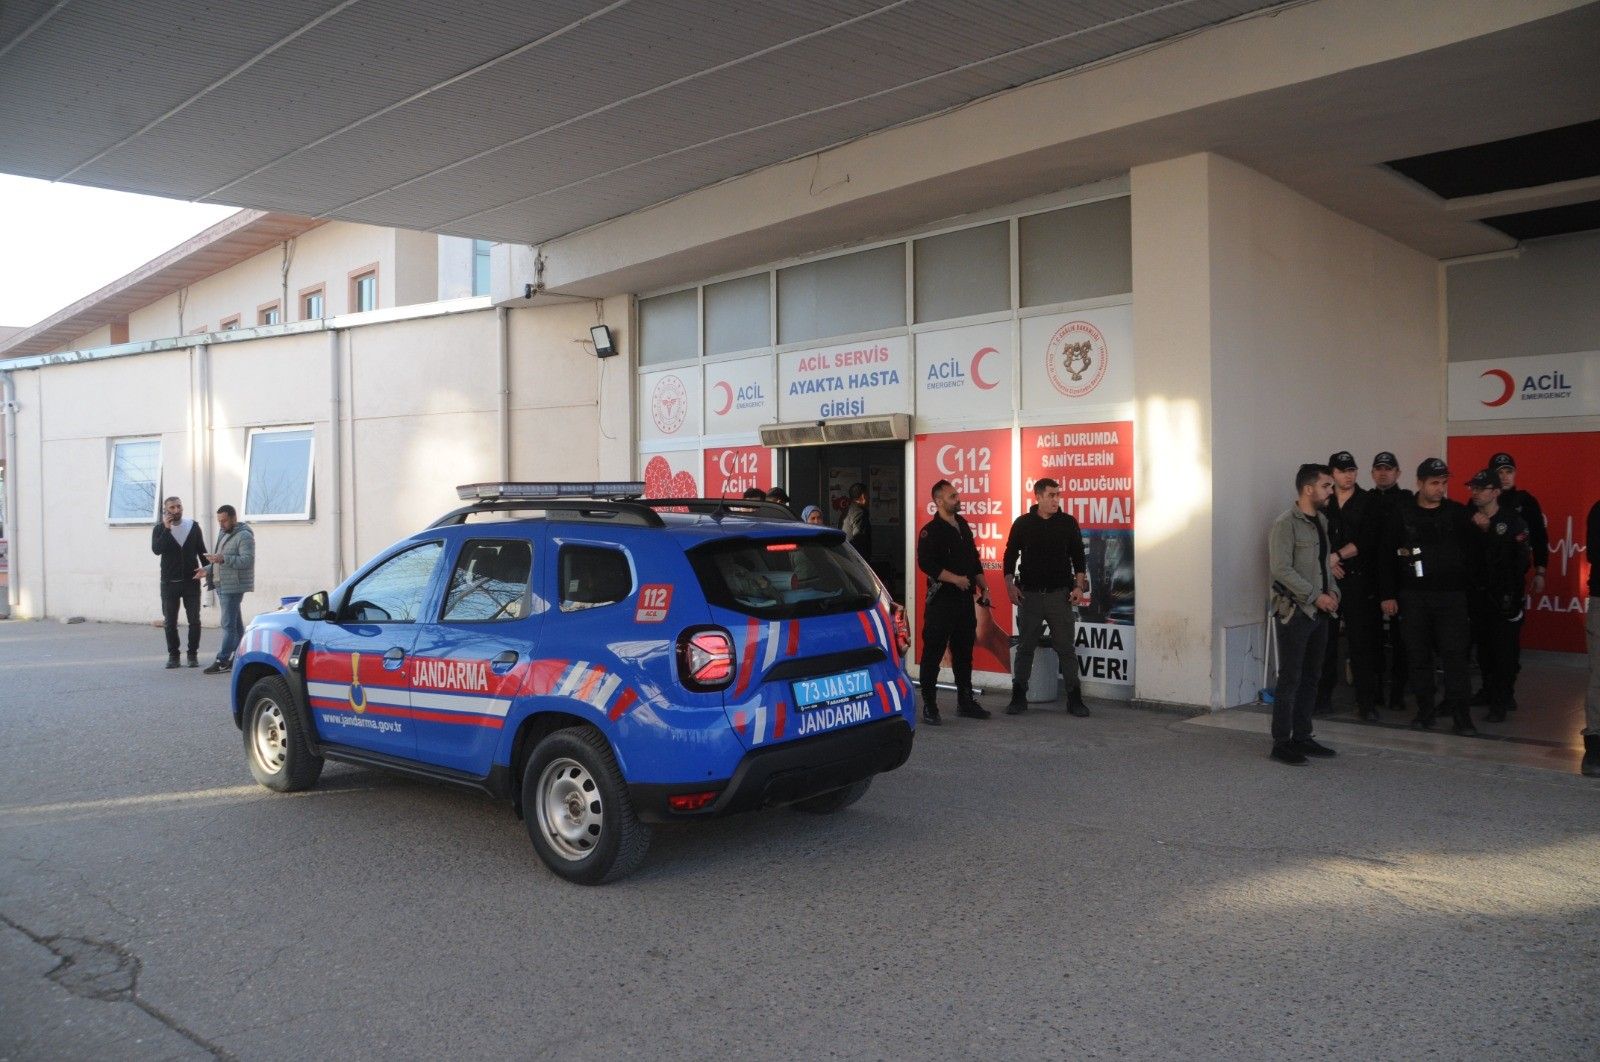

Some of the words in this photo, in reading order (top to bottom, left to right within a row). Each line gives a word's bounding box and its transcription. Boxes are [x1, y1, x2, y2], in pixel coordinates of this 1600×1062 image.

[798, 353, 830, 372] ACİL
[834, 345, 889, 368] SERVİS
[928, 357, 965, 380] ACİL
[789, 376, 844, 396] AYAKTA
[848, 369, 900, 389] HASTA
[926, 380, 965, 390] EMERGENCY
[1522, 370, 1572, 391] ACİL
[737, 382, 764, 401] ACİL
[1521, 391, 1572, 400] EMERGENCY
[820, 397, 865, 417] GİRİŞİ
[1036, 432, 1061, 448] ACİL
[1063, 431, 1119, 447] DURUMDA
[732, 452, 758, 473] 112
[954, 446, 991, 471] 112
[1041, 450, 1115, 467] SANİYELERİN
[946, 474, 990, 494] CİL'İ
[1068, 475, 1132, 492] OLDUĞUNU
[926, 498, 1003, 515] GEKSİZ
[643, 588, 667, 607] 112
[1537, 595, 1590, 613] ALA
[412, 660, 489, 691] JANDARMA
[1077, 655, 1128, 681] VER!
[801, 682, 820, 702] 73
[822, 676, 846, 698] JAA
[846, 672, 868, 692] 577
[322, 713, 402, 733] www.jandarma.gov.tr
[798, 700, 872, 735] JANDARMA
